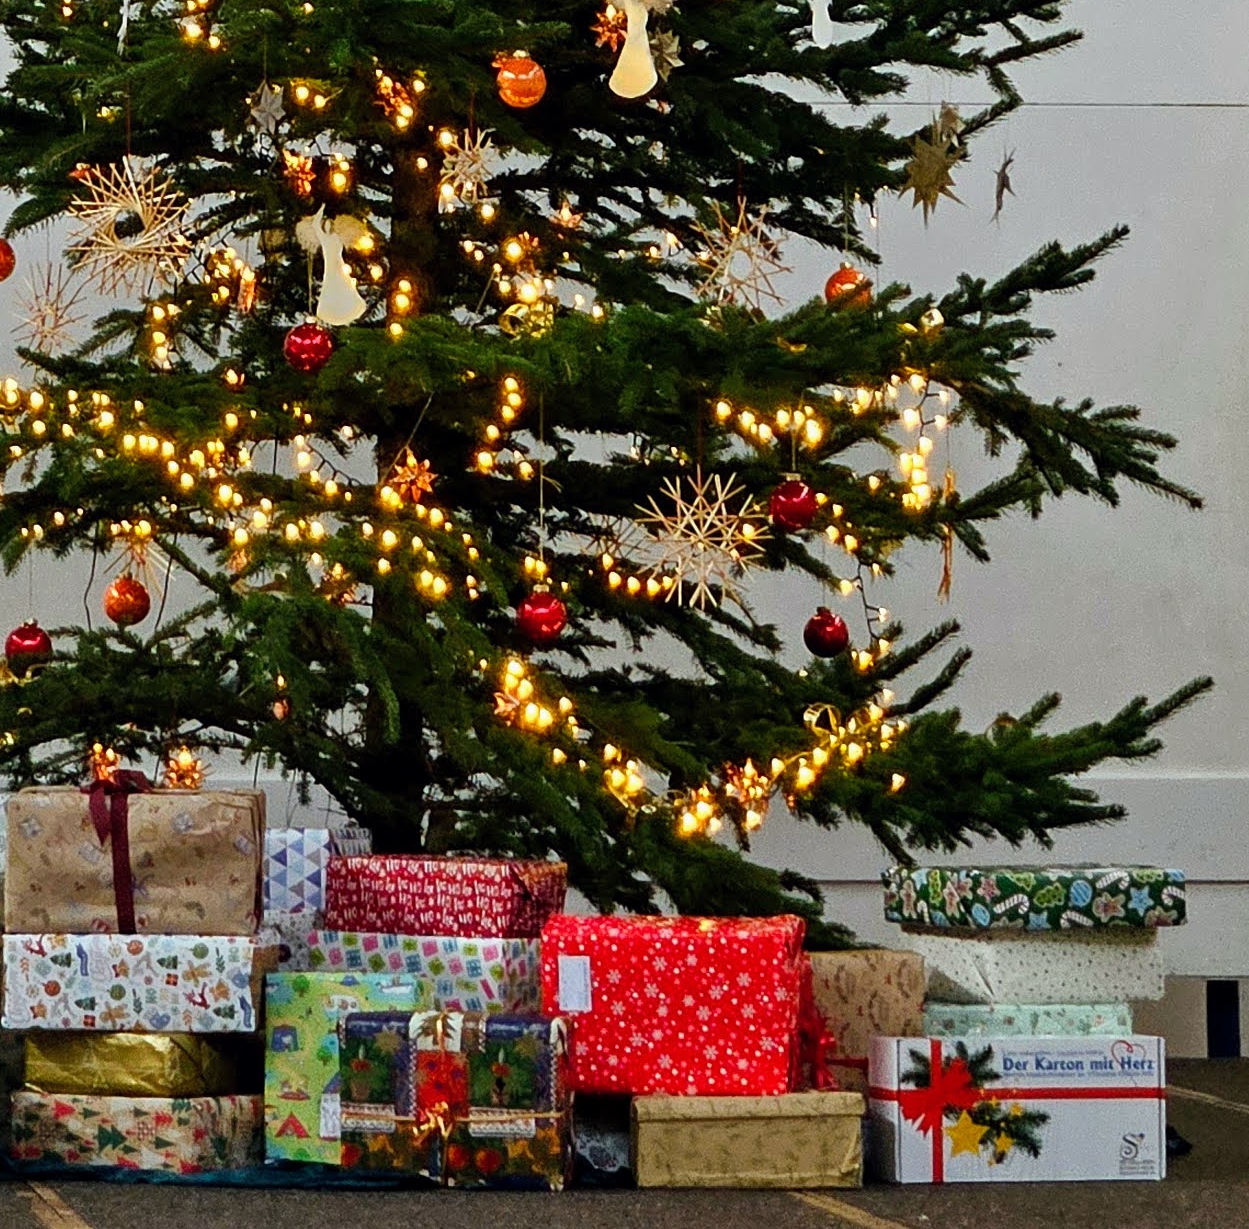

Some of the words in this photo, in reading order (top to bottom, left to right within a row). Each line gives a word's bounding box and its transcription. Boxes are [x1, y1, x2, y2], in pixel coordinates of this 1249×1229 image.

[1002, 1056, 1028, 1071] Der
[1035, 1054, 1085, 1071] Karton
[1089, 1056, 1114, 1071] mit
[1119, 1056, 1154, 1071] Herz
